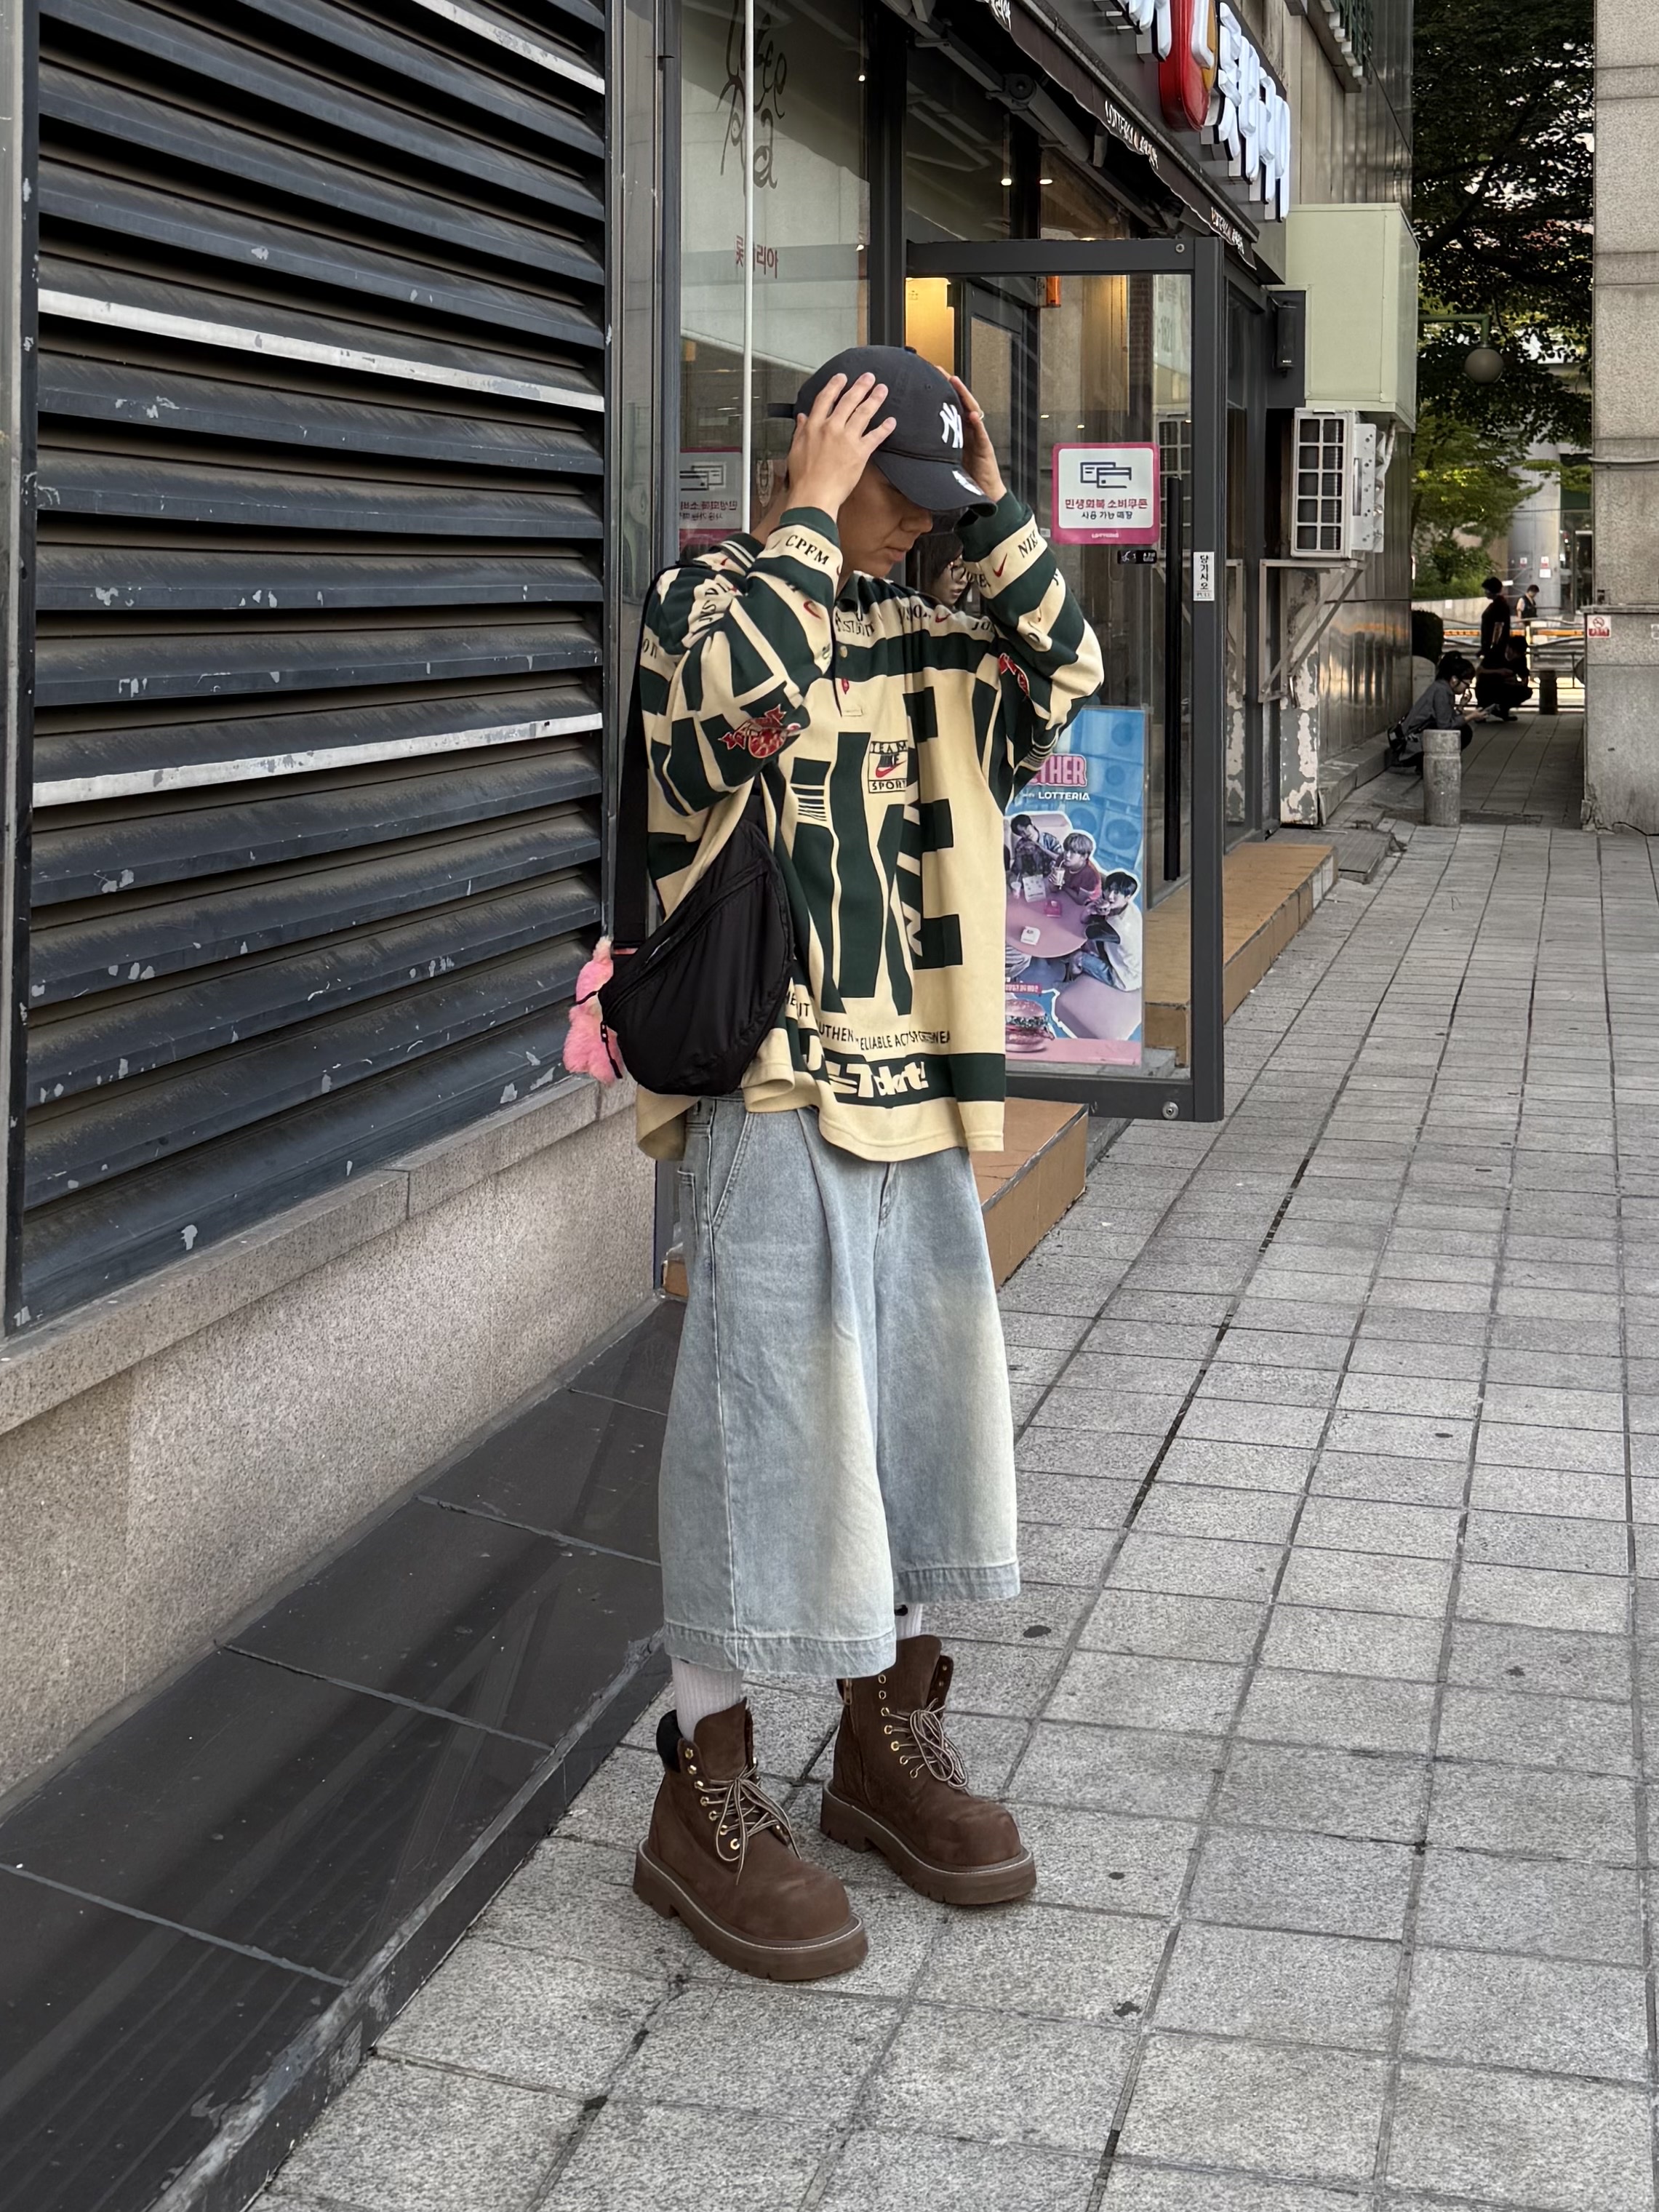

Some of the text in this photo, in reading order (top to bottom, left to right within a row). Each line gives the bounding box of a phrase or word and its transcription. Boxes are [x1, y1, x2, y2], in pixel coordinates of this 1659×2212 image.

[735, 234, 778, 279] 롯리아
[1065, 498, 1148, 509] 민생회복 소비쿠폰
[1082, 511, 1097, 519] 사용
[785, 535, 829, 564] CPFM
[1200, 555, 1208, 590] 당기시오
[872, 742, 907, 754] TEAM
[1038, 791, 1090, 801] LOTTERIA
